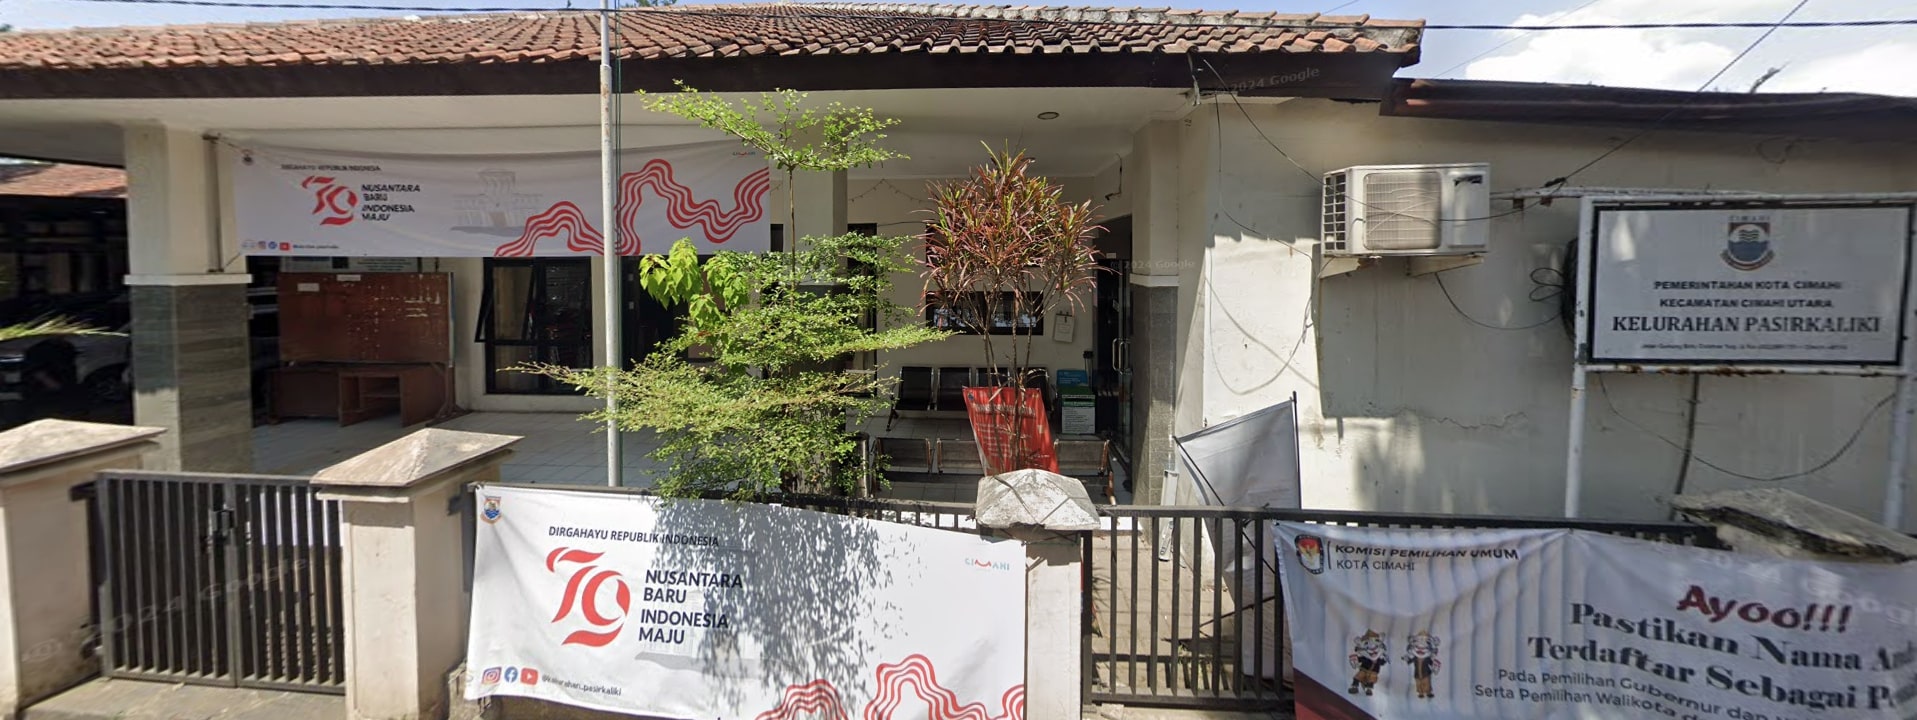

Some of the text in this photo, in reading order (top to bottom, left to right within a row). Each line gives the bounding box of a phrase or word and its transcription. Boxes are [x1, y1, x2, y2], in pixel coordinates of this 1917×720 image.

[361, 184, 421, 193] NUSANTARA
[362, 193, 388, 202] BARU
[361, 204, 415, 213] INDONESIA
[361, 213, 391, 222] MAJU
[1653, 281, 1842, 291] PEMERINTAHAN KOTA CIMAHI
[1659, 298, 1833, 309] KECAMATAN CIMAHI UTARA
[1612, 316, 1881, 333] KELURAHAN PASIRKALIKI
[548, 525, 719, 547] DIRGAHAYU REPUBLIK INDONESIA
[1335, 544, 1519, 560] KOMISI PEMILIHAN UMUM
[1336, 559, 1415, 571] KOTA CIMAHI
[645, 570, 744, 589] NUSANTARA
[546, 546, 631, 648] 79
[643, 587, 687, 604] BARU
[1676, 584, 1853, 633] Ayoo!!!
[640, 609, 729, 629] INDONESIA
[638, 627, 686, 645] MAJU
[1570, 602, 1738, 656] Pastikan
[1750, 634, 1862, 671] Nama
[1527, 636, 1696, 684] Terdaftar
[1706, 664, 1857, 712] Sebagai
[1498, 668, 1536, 685] Pada
[1542, 672, 1615, 689] Pemilihan
[1620, 677, 1722, 715] Gubernur
[1474, 684, 1677, 718] Serta Pemilihan Walikota
